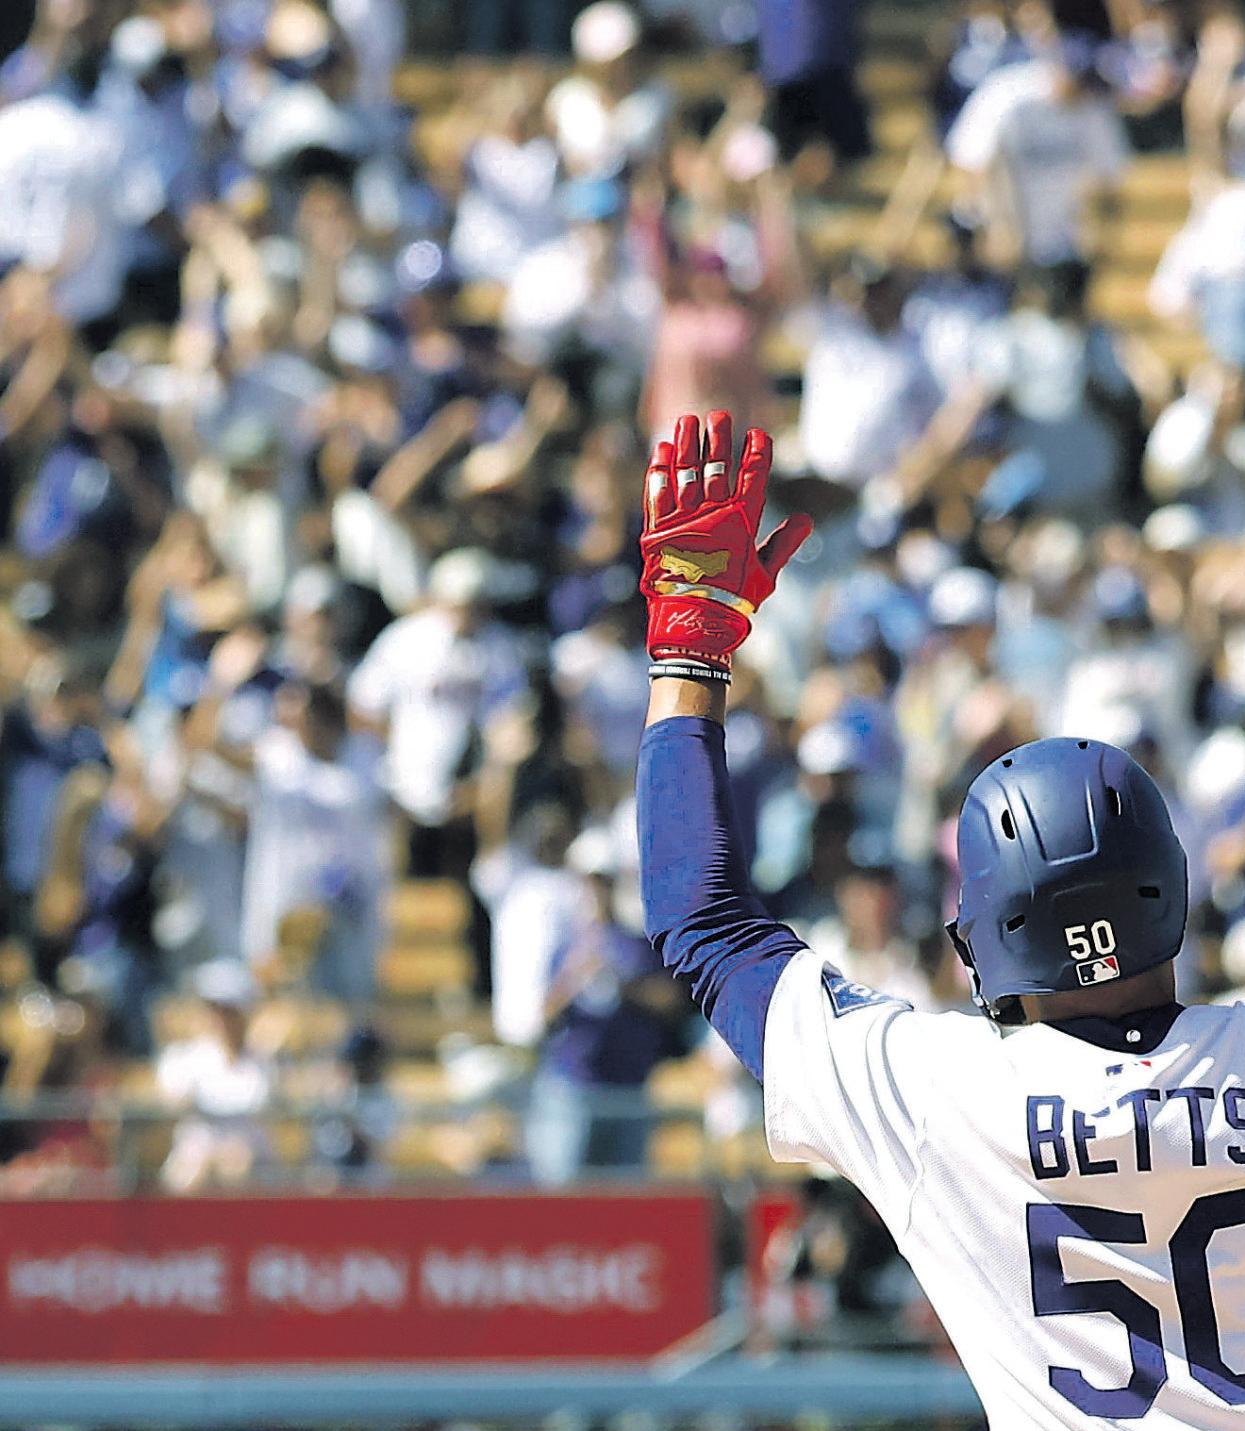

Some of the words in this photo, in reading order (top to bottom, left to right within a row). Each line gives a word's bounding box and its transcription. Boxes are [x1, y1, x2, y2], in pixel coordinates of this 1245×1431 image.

[1064, 919, 1117, 961] 50
[8, 1245, 226, 1313] HOME
[248, 1245, 405, 1313] RUN
[421, 1243, 662, 1312] MAGIC
